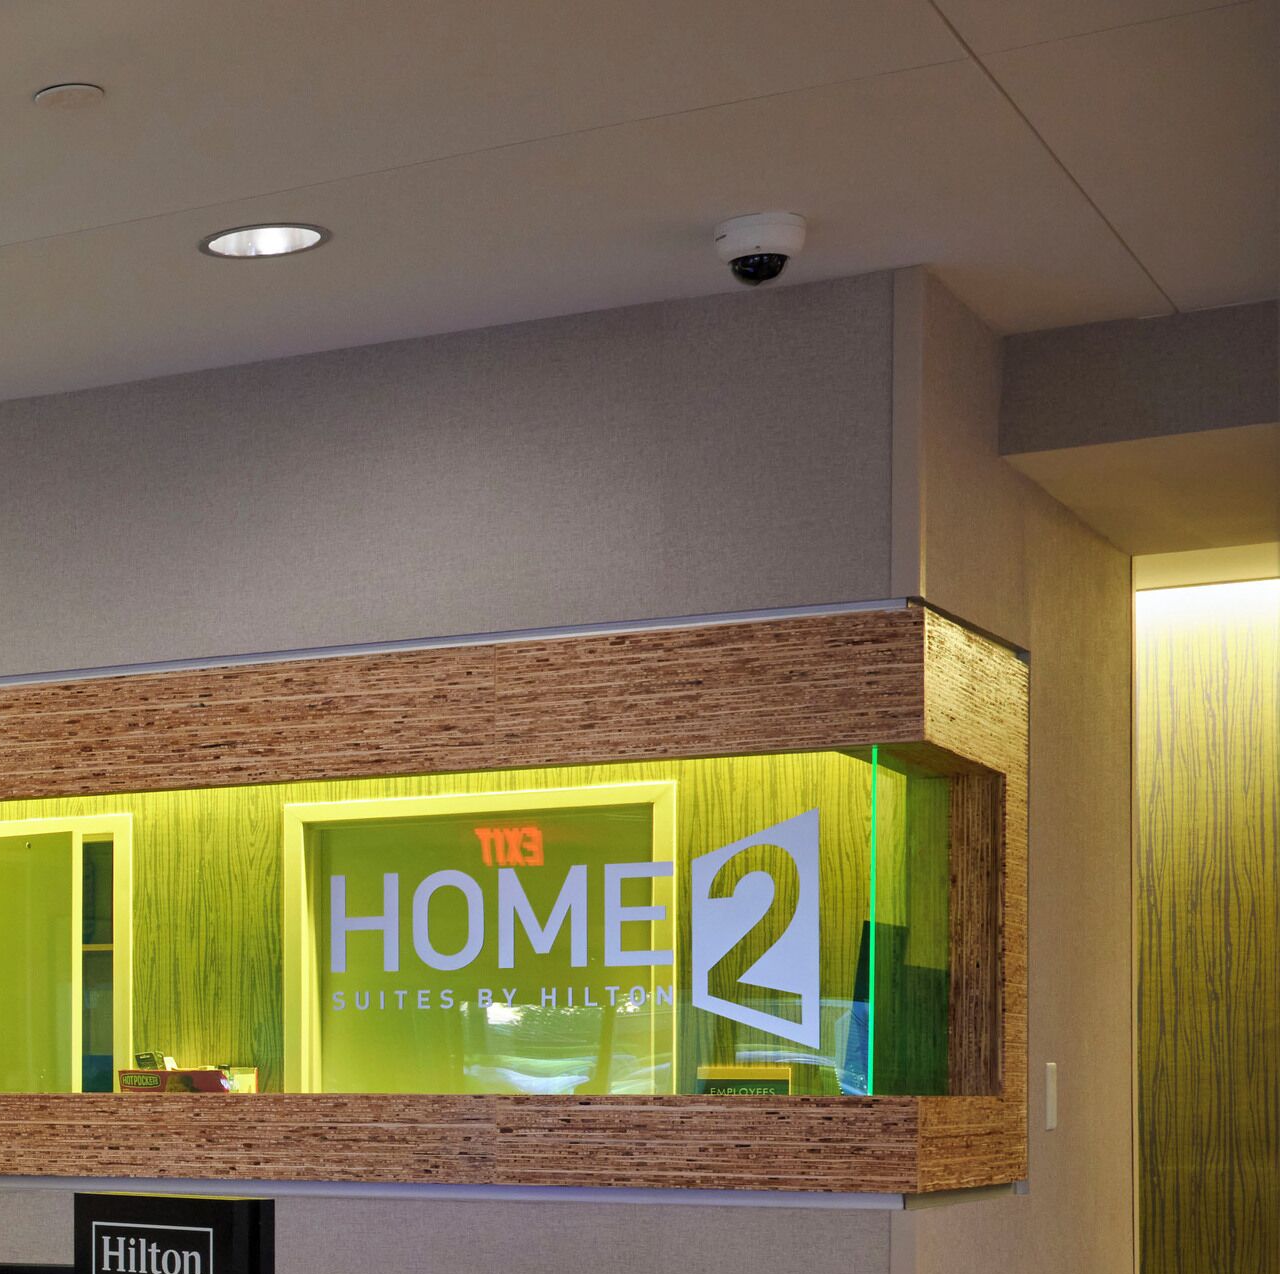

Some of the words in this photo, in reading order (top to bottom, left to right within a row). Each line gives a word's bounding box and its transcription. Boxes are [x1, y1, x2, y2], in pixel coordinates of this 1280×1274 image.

[332, 989, 454, 1012] SUITES
[478, 988, 517, 1008] BY
[541, 985, 673, 1008] HILTON
